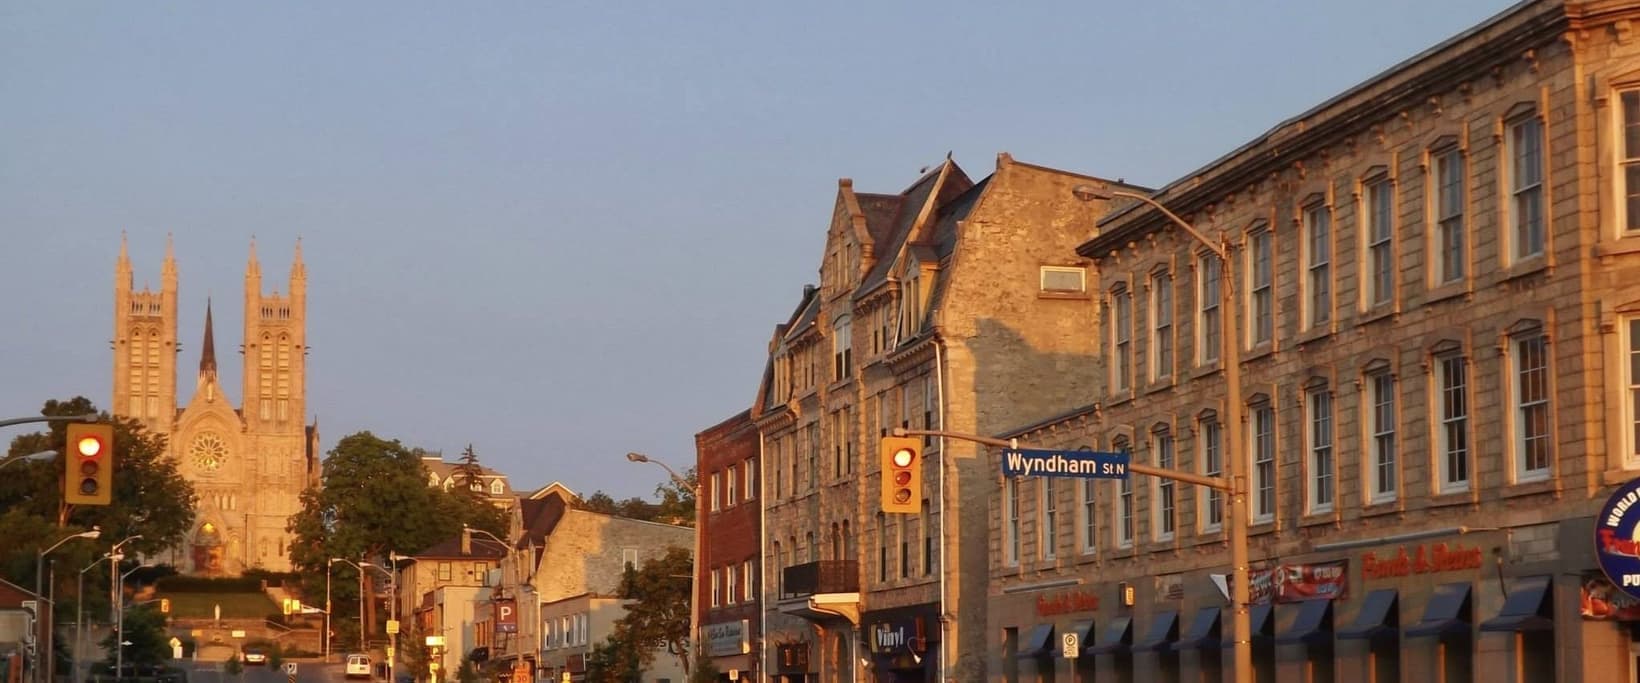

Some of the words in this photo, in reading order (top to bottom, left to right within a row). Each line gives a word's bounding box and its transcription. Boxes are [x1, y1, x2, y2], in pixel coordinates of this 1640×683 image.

[1007, 452, 1096, 476] Wyndham
[1102, 463, 1114, 475] St
[1116, 463, 1125, 475] N
[1606, 490, 1638, 527] WORLD
[500, 606, 512, 621] P
[877, 626, 904, 648] Vinyl
